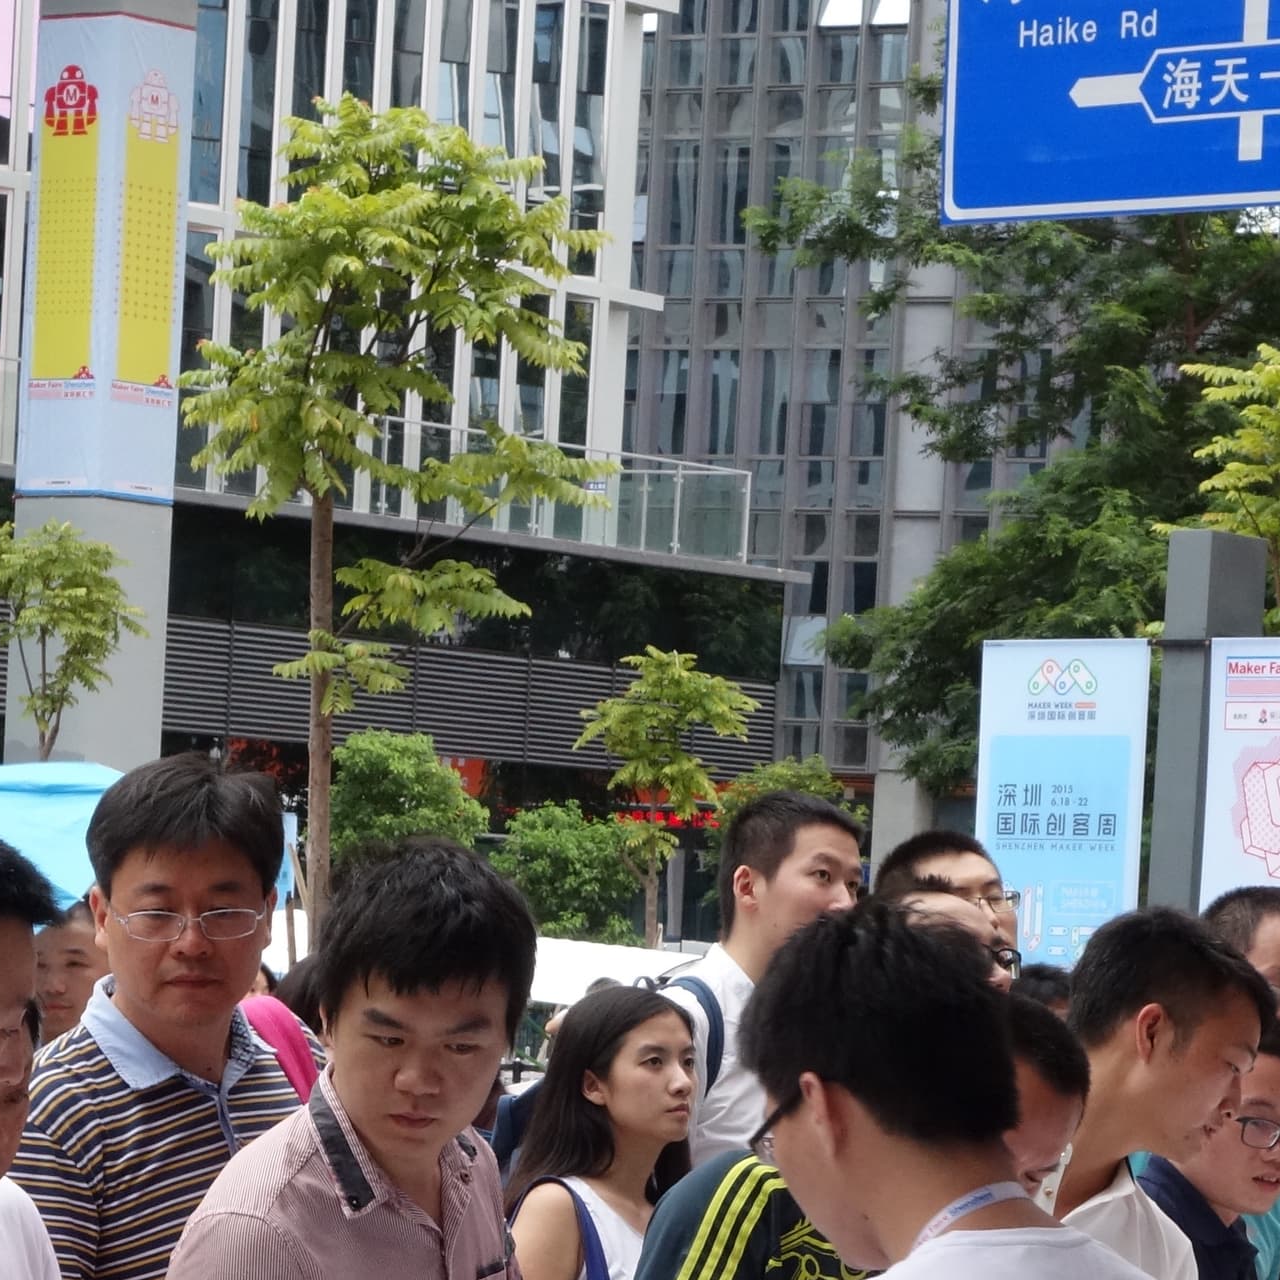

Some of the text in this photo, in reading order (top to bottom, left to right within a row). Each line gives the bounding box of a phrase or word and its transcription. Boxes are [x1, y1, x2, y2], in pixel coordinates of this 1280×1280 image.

[1019, 8, 1157, 47] Haike Rd
[1228, 661, 1266, 675] Maker
[997, 783, 1042, 807] 深圳
[1051, 784, 1073, 794] 2015
[996, 812, 1117, 837] 国际创客周
[995, 842, 1116, 852] SHENZHEN MAKER WEEK
